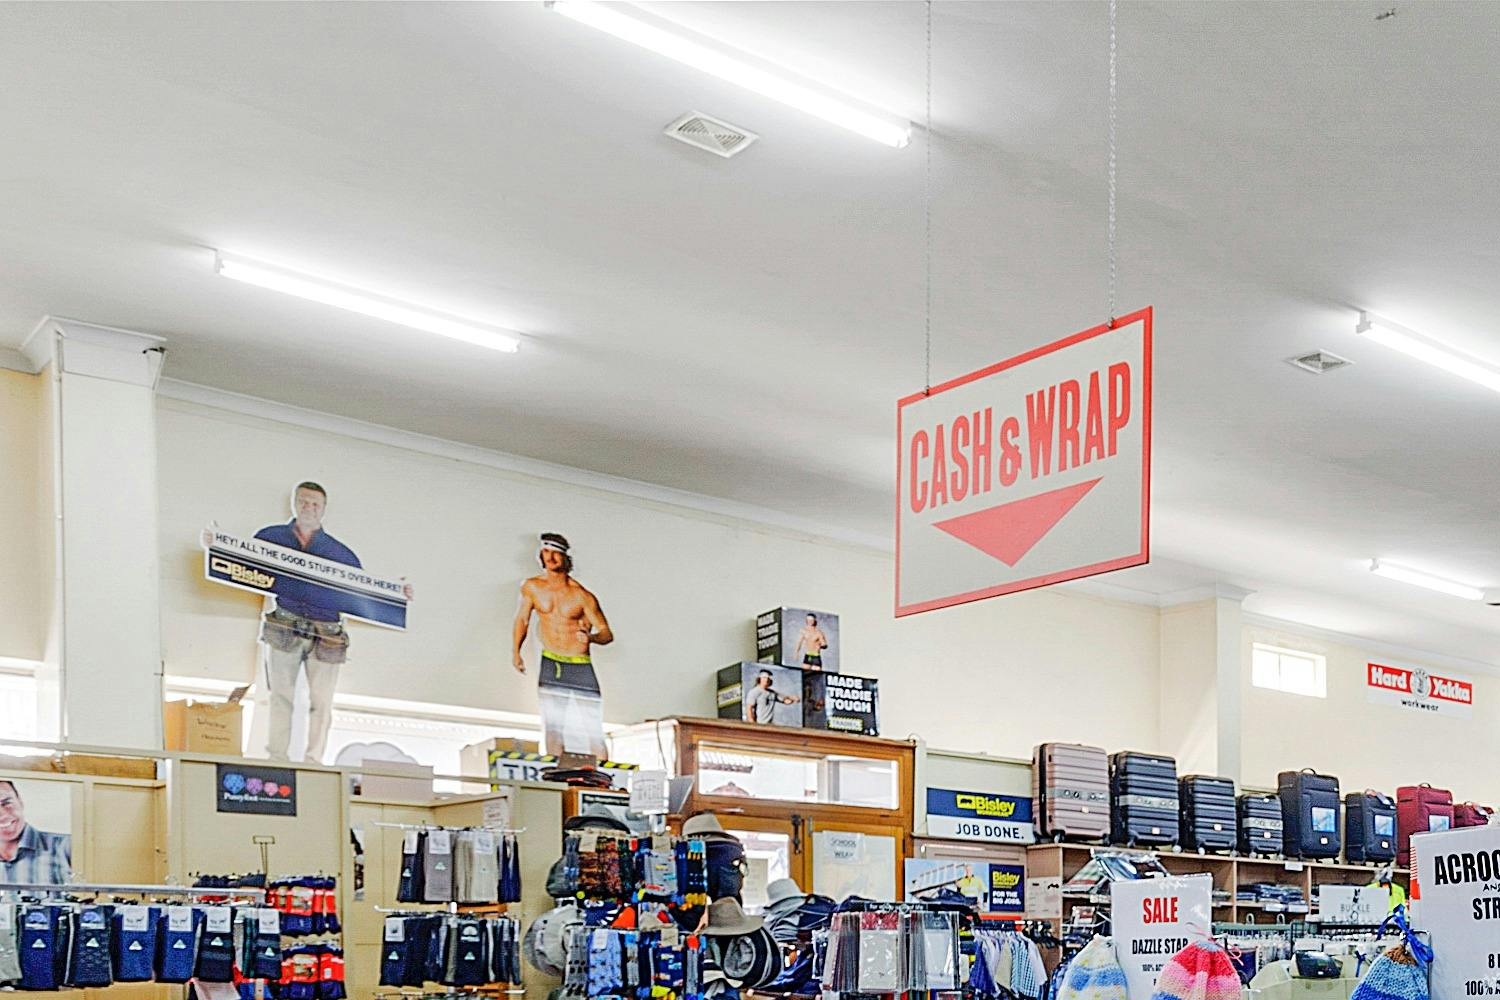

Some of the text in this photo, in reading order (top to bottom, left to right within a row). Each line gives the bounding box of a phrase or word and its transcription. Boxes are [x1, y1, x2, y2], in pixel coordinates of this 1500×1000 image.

[910, 361, 1131, 514] CASH & WRAP
[215, 533, 238, 547] HEY!
[240, 541, 258, 554] ALL
[260, 546, 279, 560] THE
[281, 552, 306, 568] GOOD
[308, 561, 346, 579] STUFF'S
[348, 572, 373, 586] OVER
[231, 562, 275, 587] Bisley
[827, 675, 863, 690] MADE
[1370, 666, 1470, 701] Hard Yakka
[827, 686, 872, 702] TRADIE
[827, 698, 872, 713] TOUGH
[1400, 699, 1439, 711] workwear
[975, 796, 1016, 815] Bisley
[955, 823, 1025, 840] JOB DONE.
[992, 871, 1020, 887] Bisley
[992, 890, 1019, 899] FOR THE
[1143, 896, 1179, 924] SALE
[1340, 902, 1371, 913] BUCKLE
[1132, 939, 1163, 955] DAZZLE
[1488, 953, 1495, 968] 8
[1465, 979, 1494, 996] 100%
